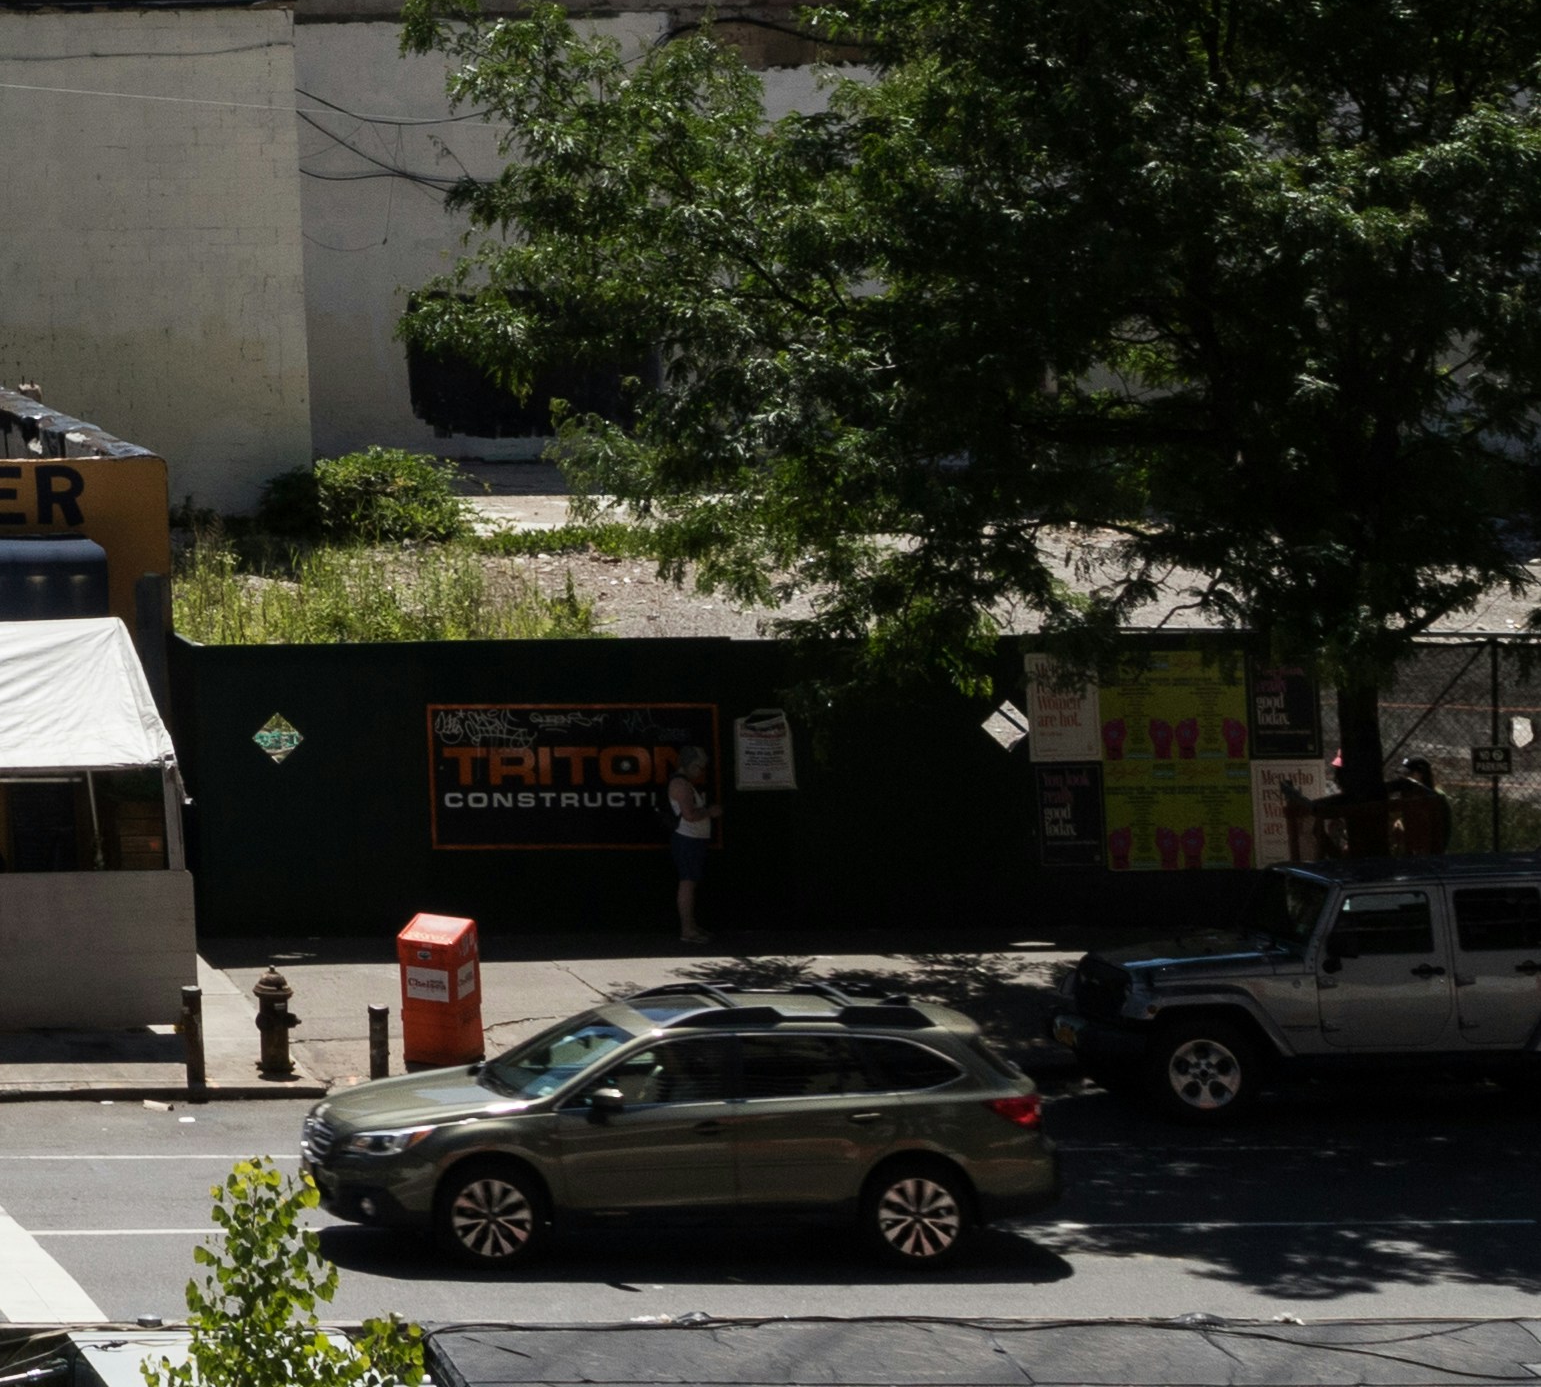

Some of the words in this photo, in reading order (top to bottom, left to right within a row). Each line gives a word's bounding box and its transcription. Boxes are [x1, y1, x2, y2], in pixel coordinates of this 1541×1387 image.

[1256, 694, 1285, 714] good
[1037, 715, 1056, 728] are
[441, 744, 707, 787] TRITON
[1288, 769, 1314, 786] who
[443, 791, 707, 809] CONSTRUCTI
[1044, 804, 1072, 824] good
[408, 977, 447, 991] Chelsea
